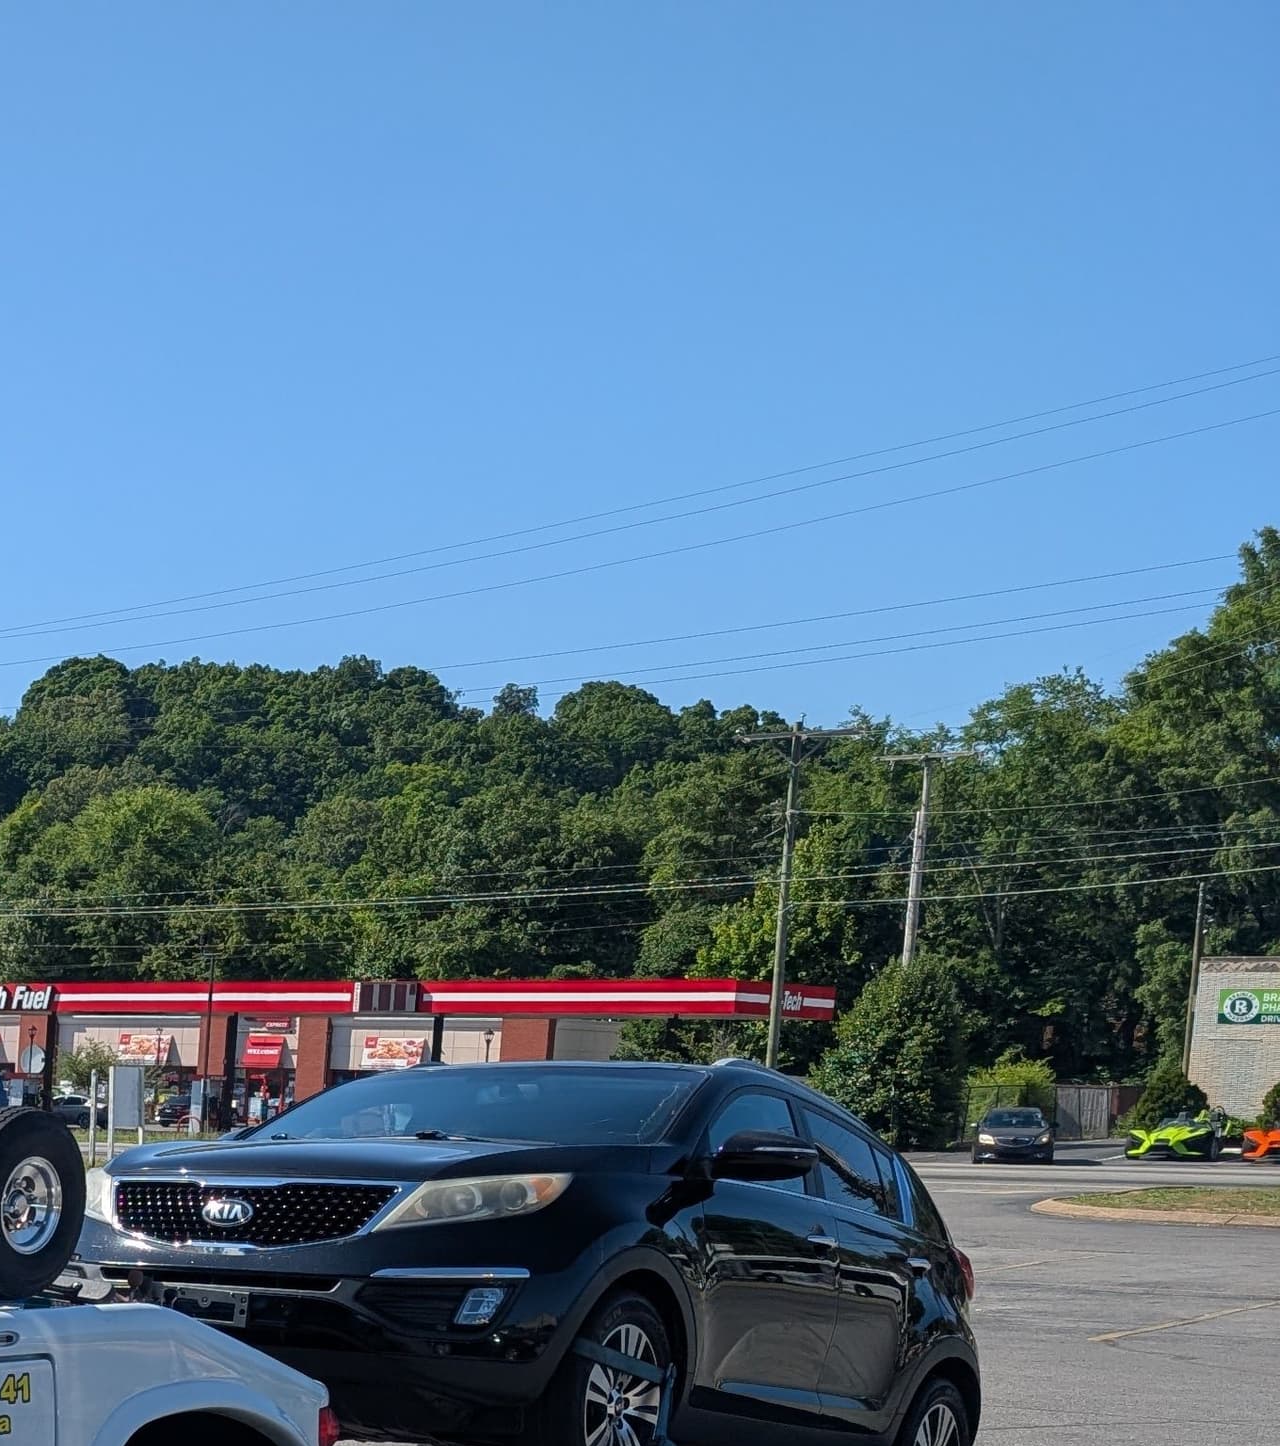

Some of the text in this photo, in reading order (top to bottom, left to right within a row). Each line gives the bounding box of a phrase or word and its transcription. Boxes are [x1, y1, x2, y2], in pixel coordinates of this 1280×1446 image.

[11, 986, 52, 1009] Fuel
[780, 990, 802, 1011] -Tech
[208, 1202, 244, 1220] KIA
[0, 1373, 31, 1404] 41
